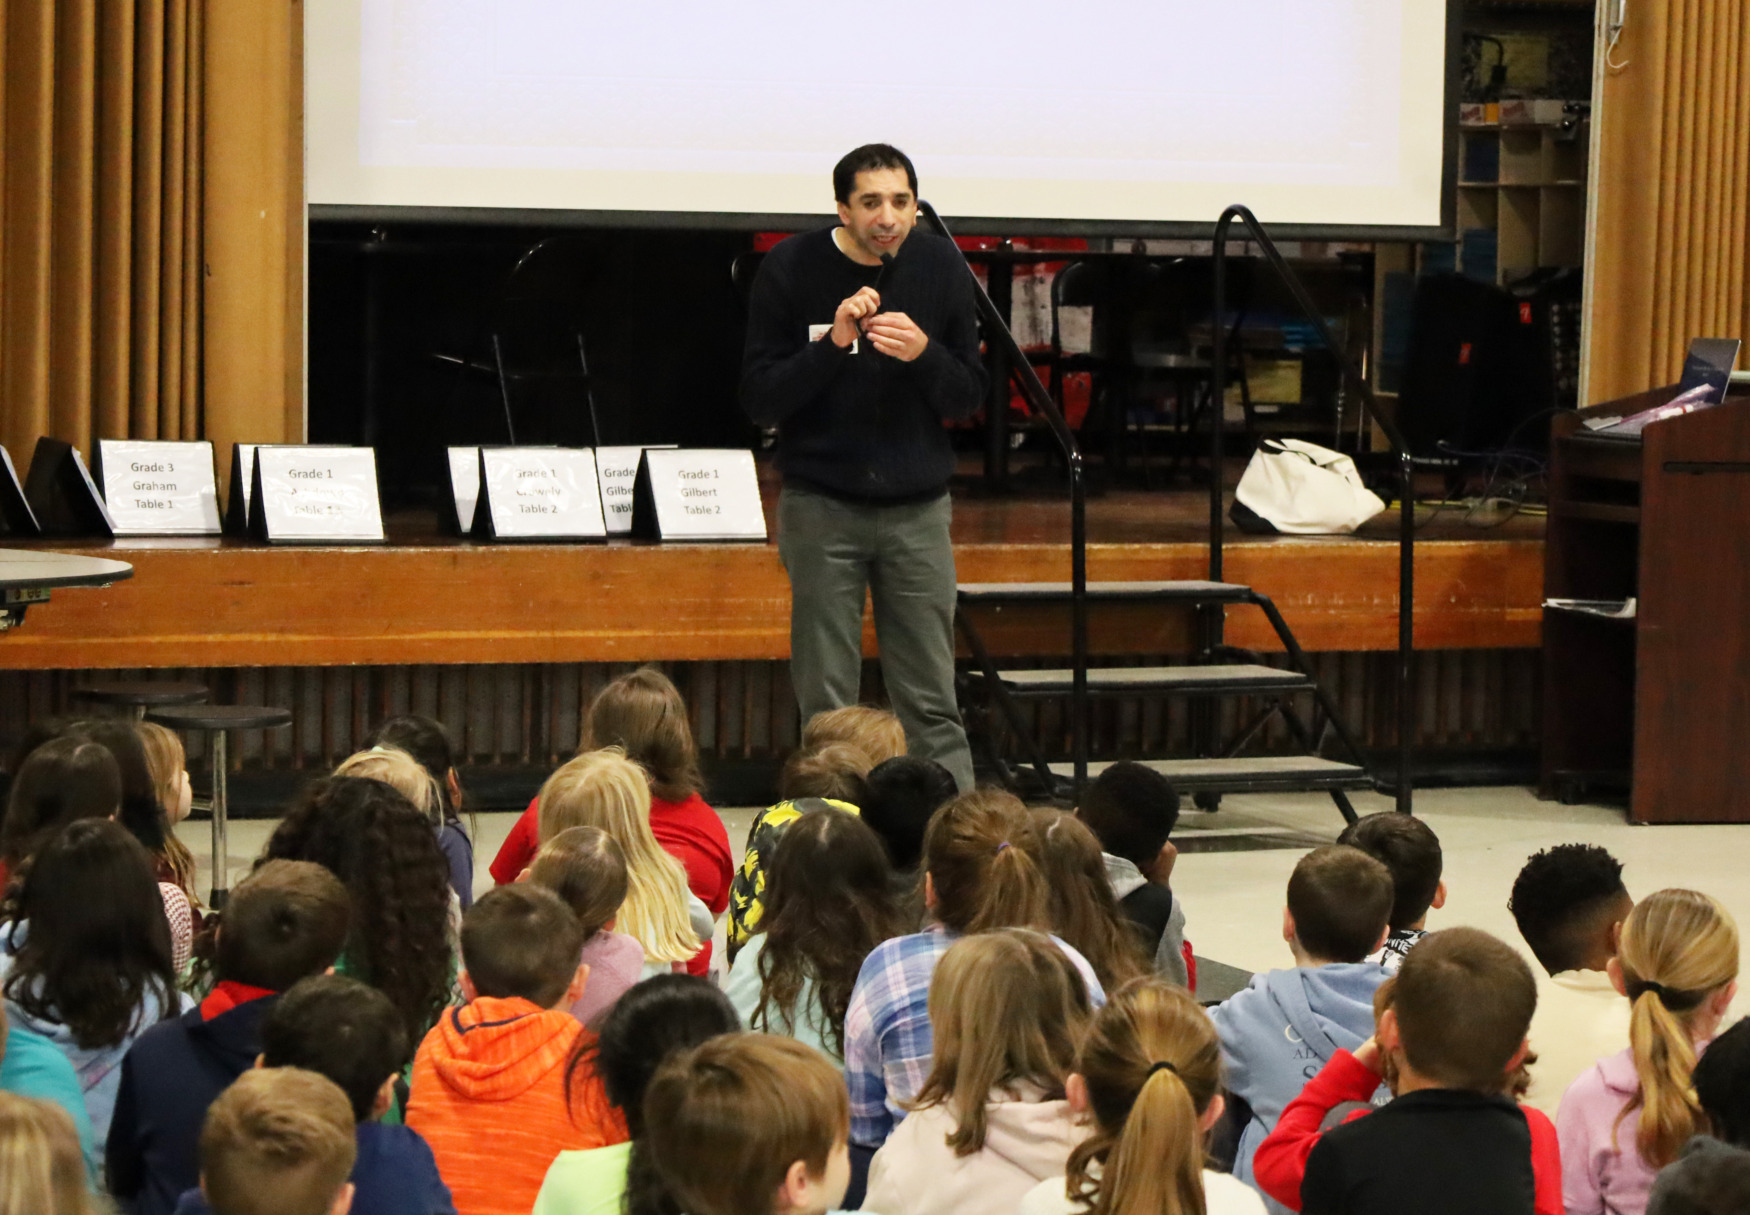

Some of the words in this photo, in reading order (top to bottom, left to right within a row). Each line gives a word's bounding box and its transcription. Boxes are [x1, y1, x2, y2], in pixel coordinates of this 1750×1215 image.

[130, 462, 164, 472] Grade
[167, 463, 174, 472] 3
[288, 469, 323, 479] Grade
[327, 469, 333, 479] 1
[551, 468, 557, 478] 1
[604, 467, 635, 478] Grade
[678, 469, 710, 479] Grade
[713, 469, 719, 479] 1
[133, 481, 177, 491] Graham
[606, 486, 633, 496] Gilbe
[681, 487, 717, 497] Gilbert
[134, 499, 164, 509] Table
[167, 499, 173, 509] 1
[519, 504, 548, 514] Table
[551, 504, 558, 514] 2
[609, 504, 632, 513] Tabl
[684, 505, 712, 515] Table
[715, 505, 721, 515] 2
